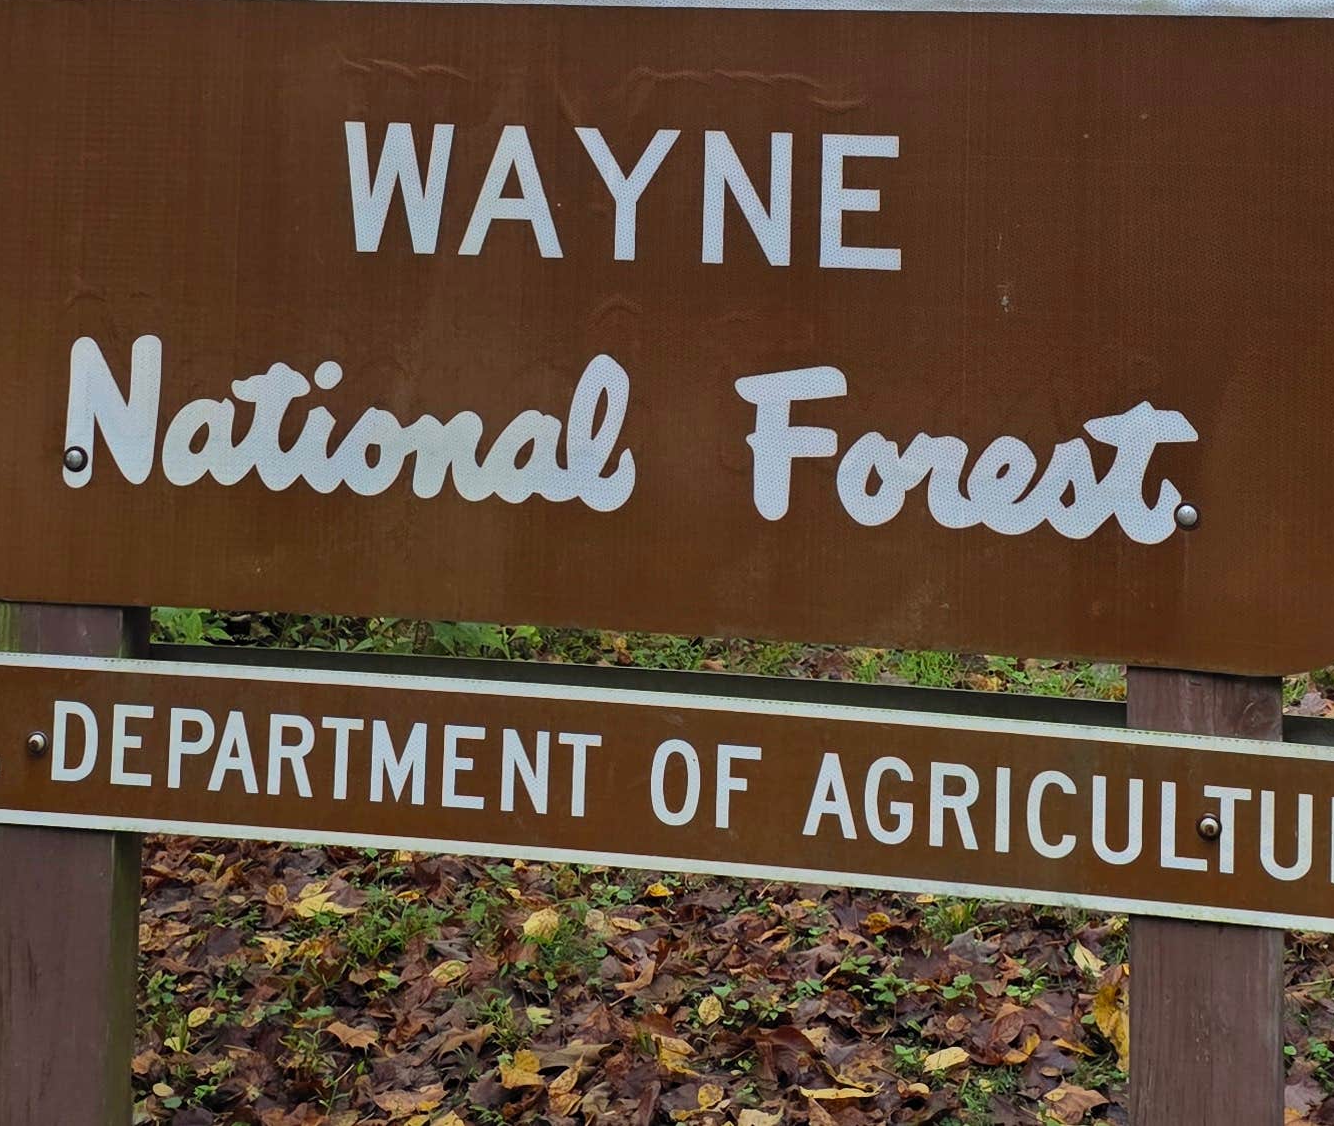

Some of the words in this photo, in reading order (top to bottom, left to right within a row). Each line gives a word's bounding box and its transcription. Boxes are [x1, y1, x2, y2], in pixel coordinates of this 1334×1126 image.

[344, 121, 902, 271] WAYNE
[63, 334, 635, 511] National
[735, 366, 1199, 544] Forest
[52, 701, 602, 819] DEPARTMENT
[652, 738, 763, 831] OF
